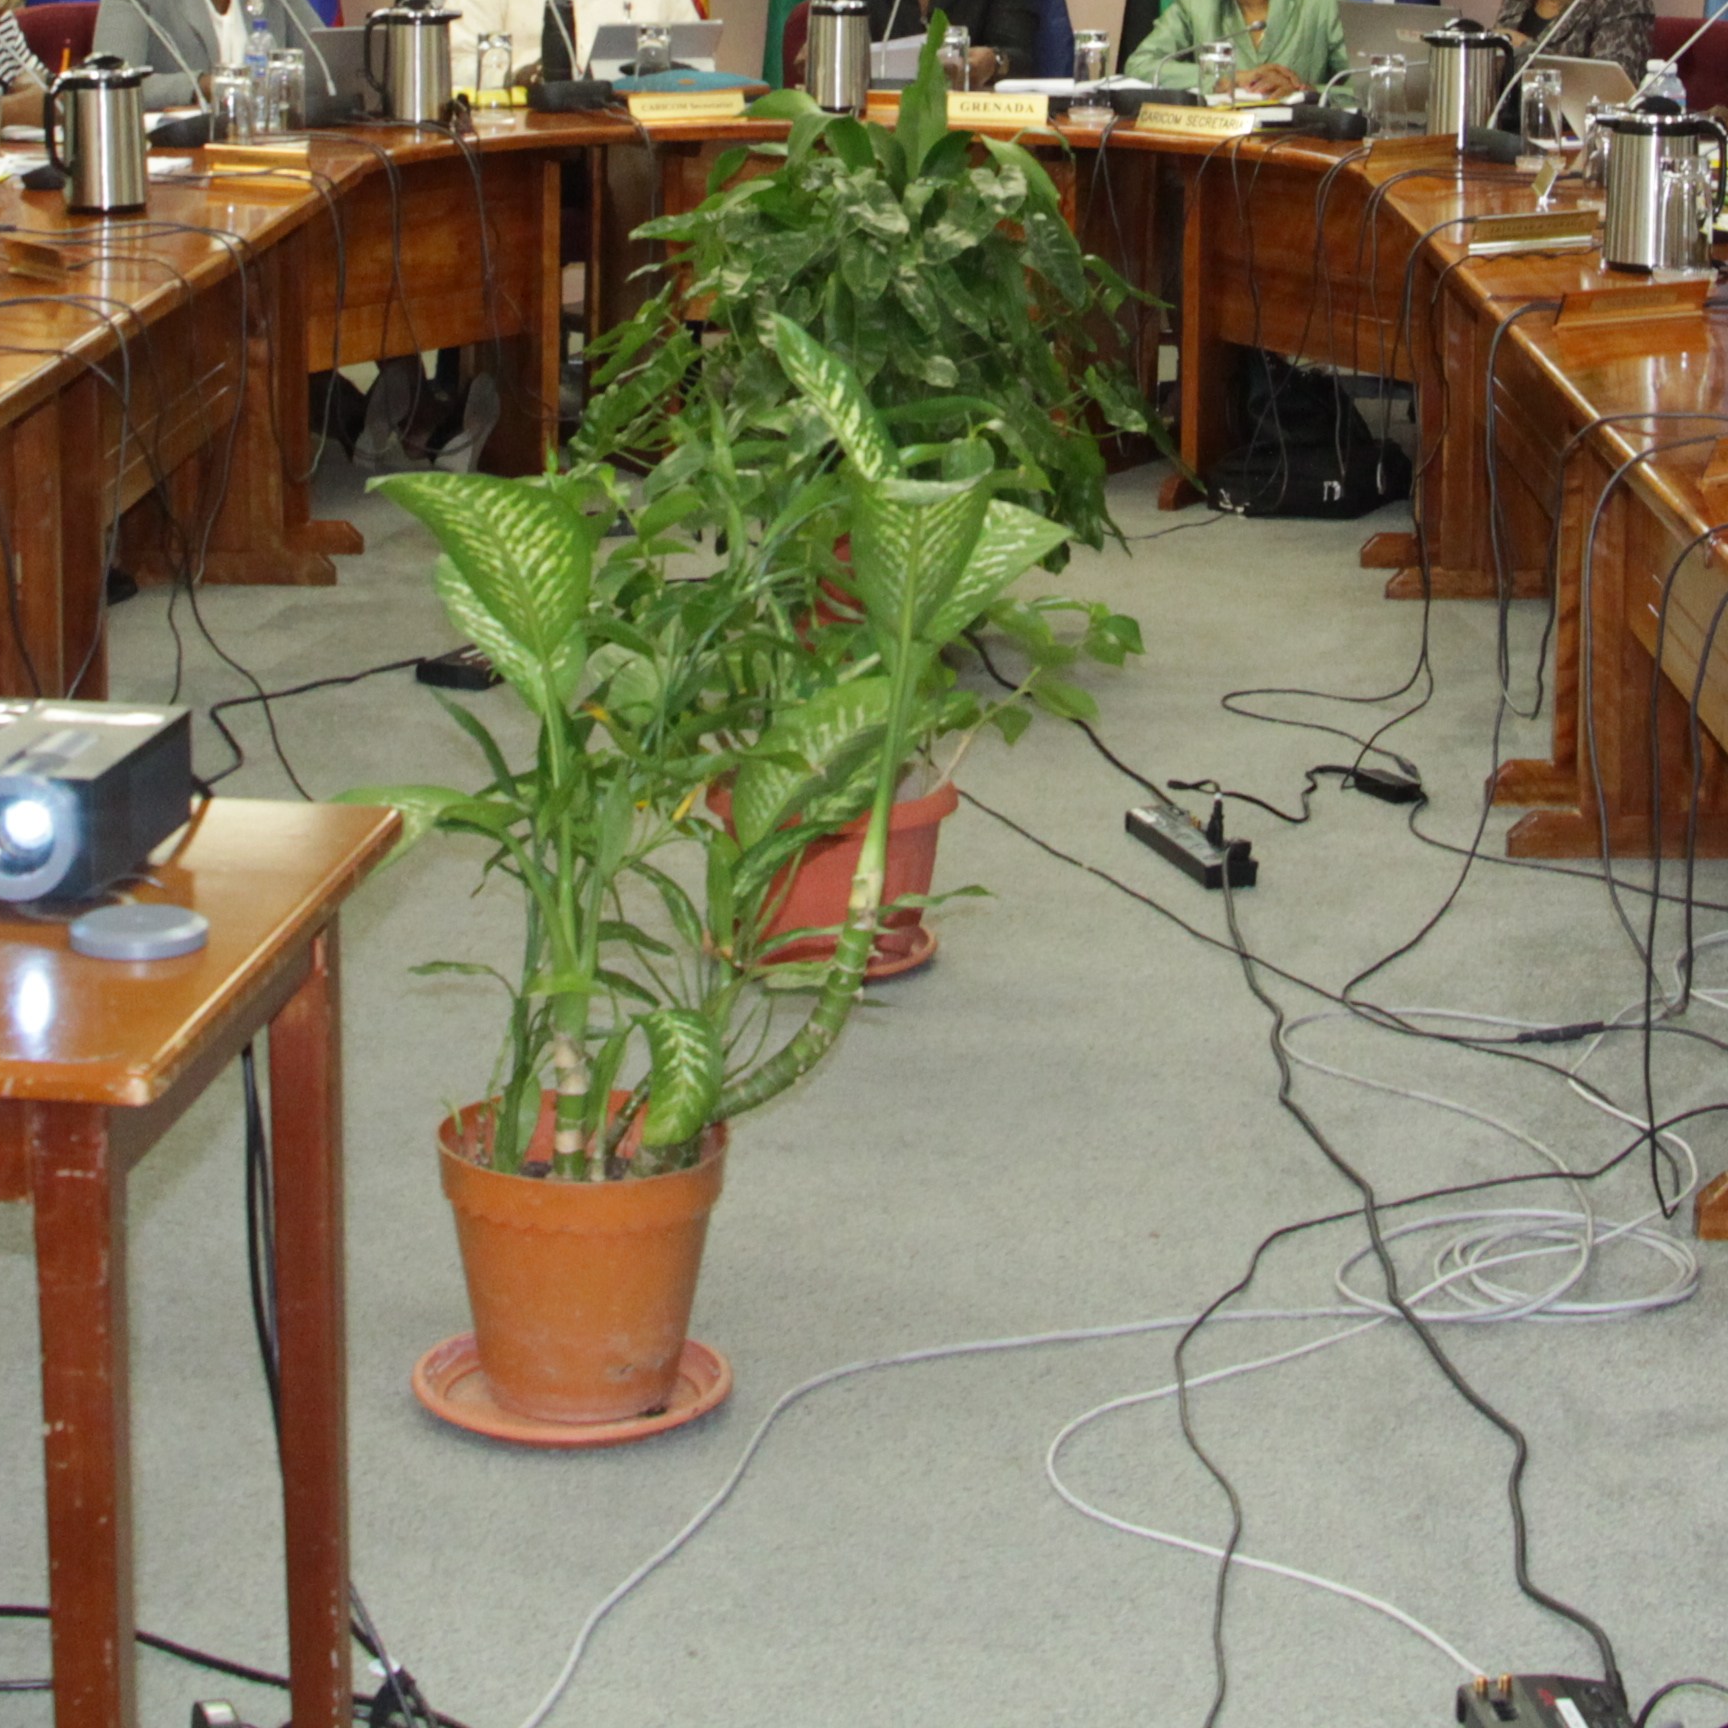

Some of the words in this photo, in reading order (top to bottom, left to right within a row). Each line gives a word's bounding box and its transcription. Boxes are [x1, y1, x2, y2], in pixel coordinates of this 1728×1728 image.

[641, 101, 688, 112] CARICOM
[959, 101, 1035, 114] GRENADA
[1140, 109, 1182, 125] CARICOM
